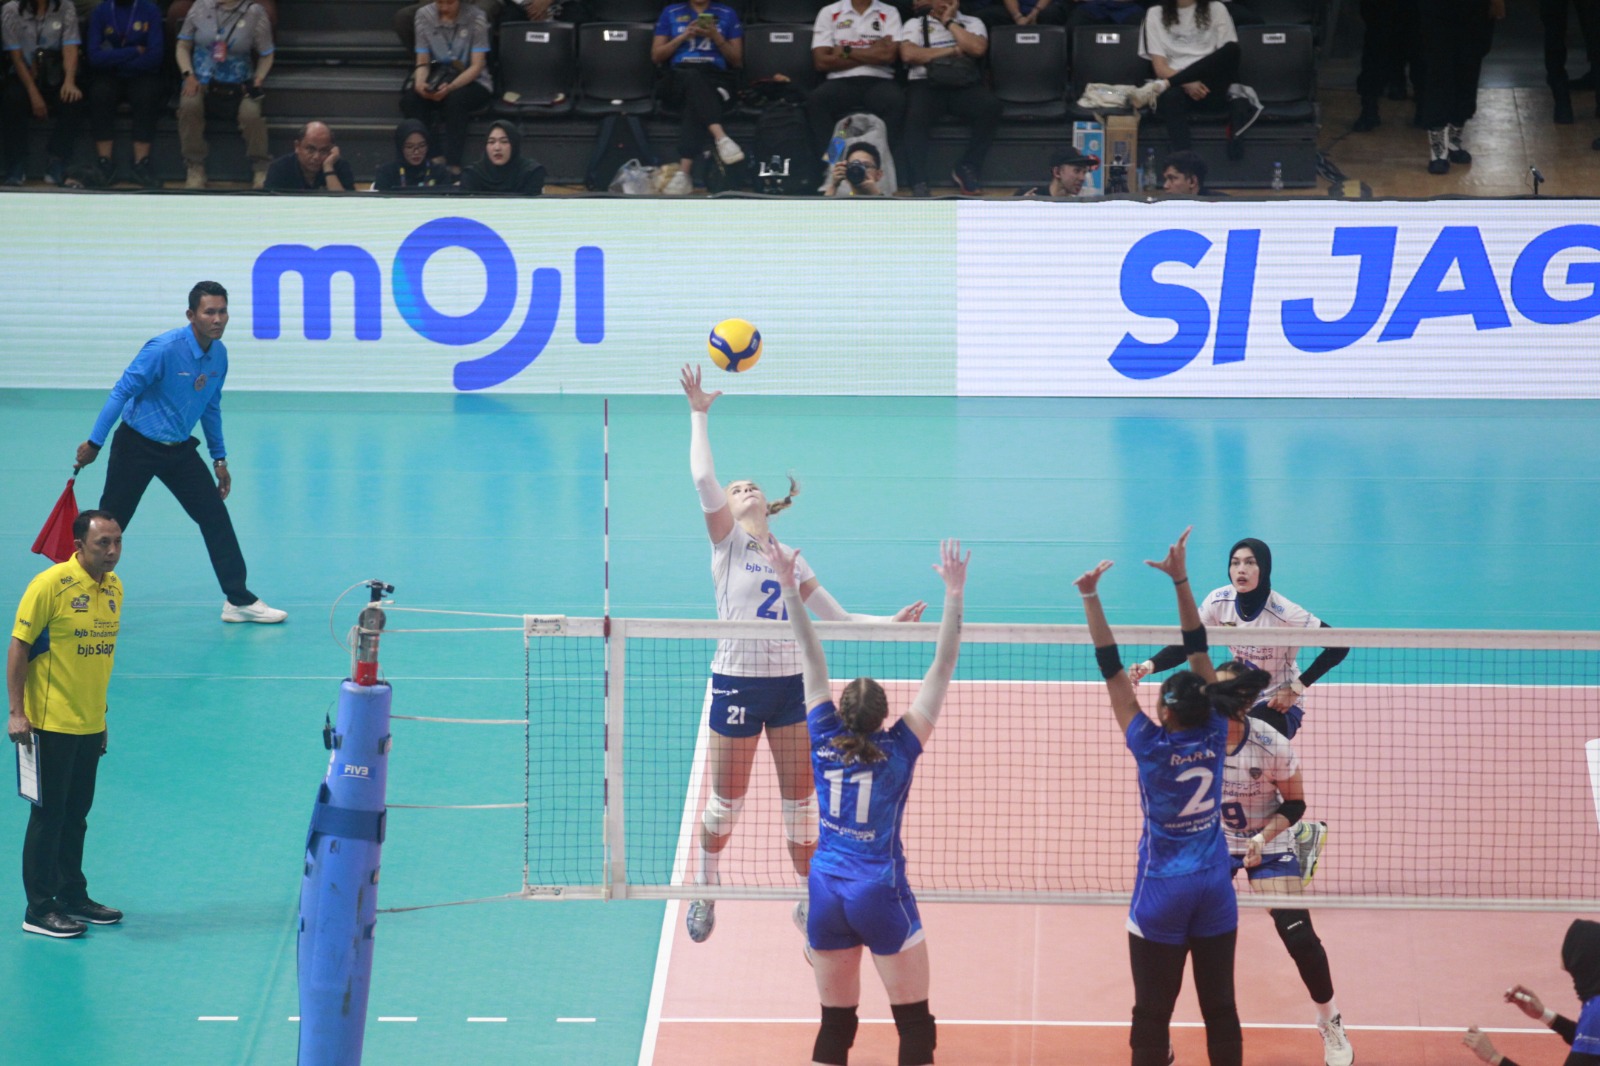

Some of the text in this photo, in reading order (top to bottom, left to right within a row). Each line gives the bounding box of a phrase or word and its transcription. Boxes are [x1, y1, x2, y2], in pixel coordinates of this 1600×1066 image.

[252, 216, 605, 391] moji
[1107, 223, 1600, 380] SI JAG
[746, 562, 761, 573] bjb
[74, 628, 88, 638] bjb
[77, 643, 95, 657] bjb
[726, 705, 746, 725] 21
[1170, 748, 1217, 767] RARA
[823, 768, 873, 824] 11
[1175, 766, 1215, 817] 2
[1220, 802, 1248, 830] 9
